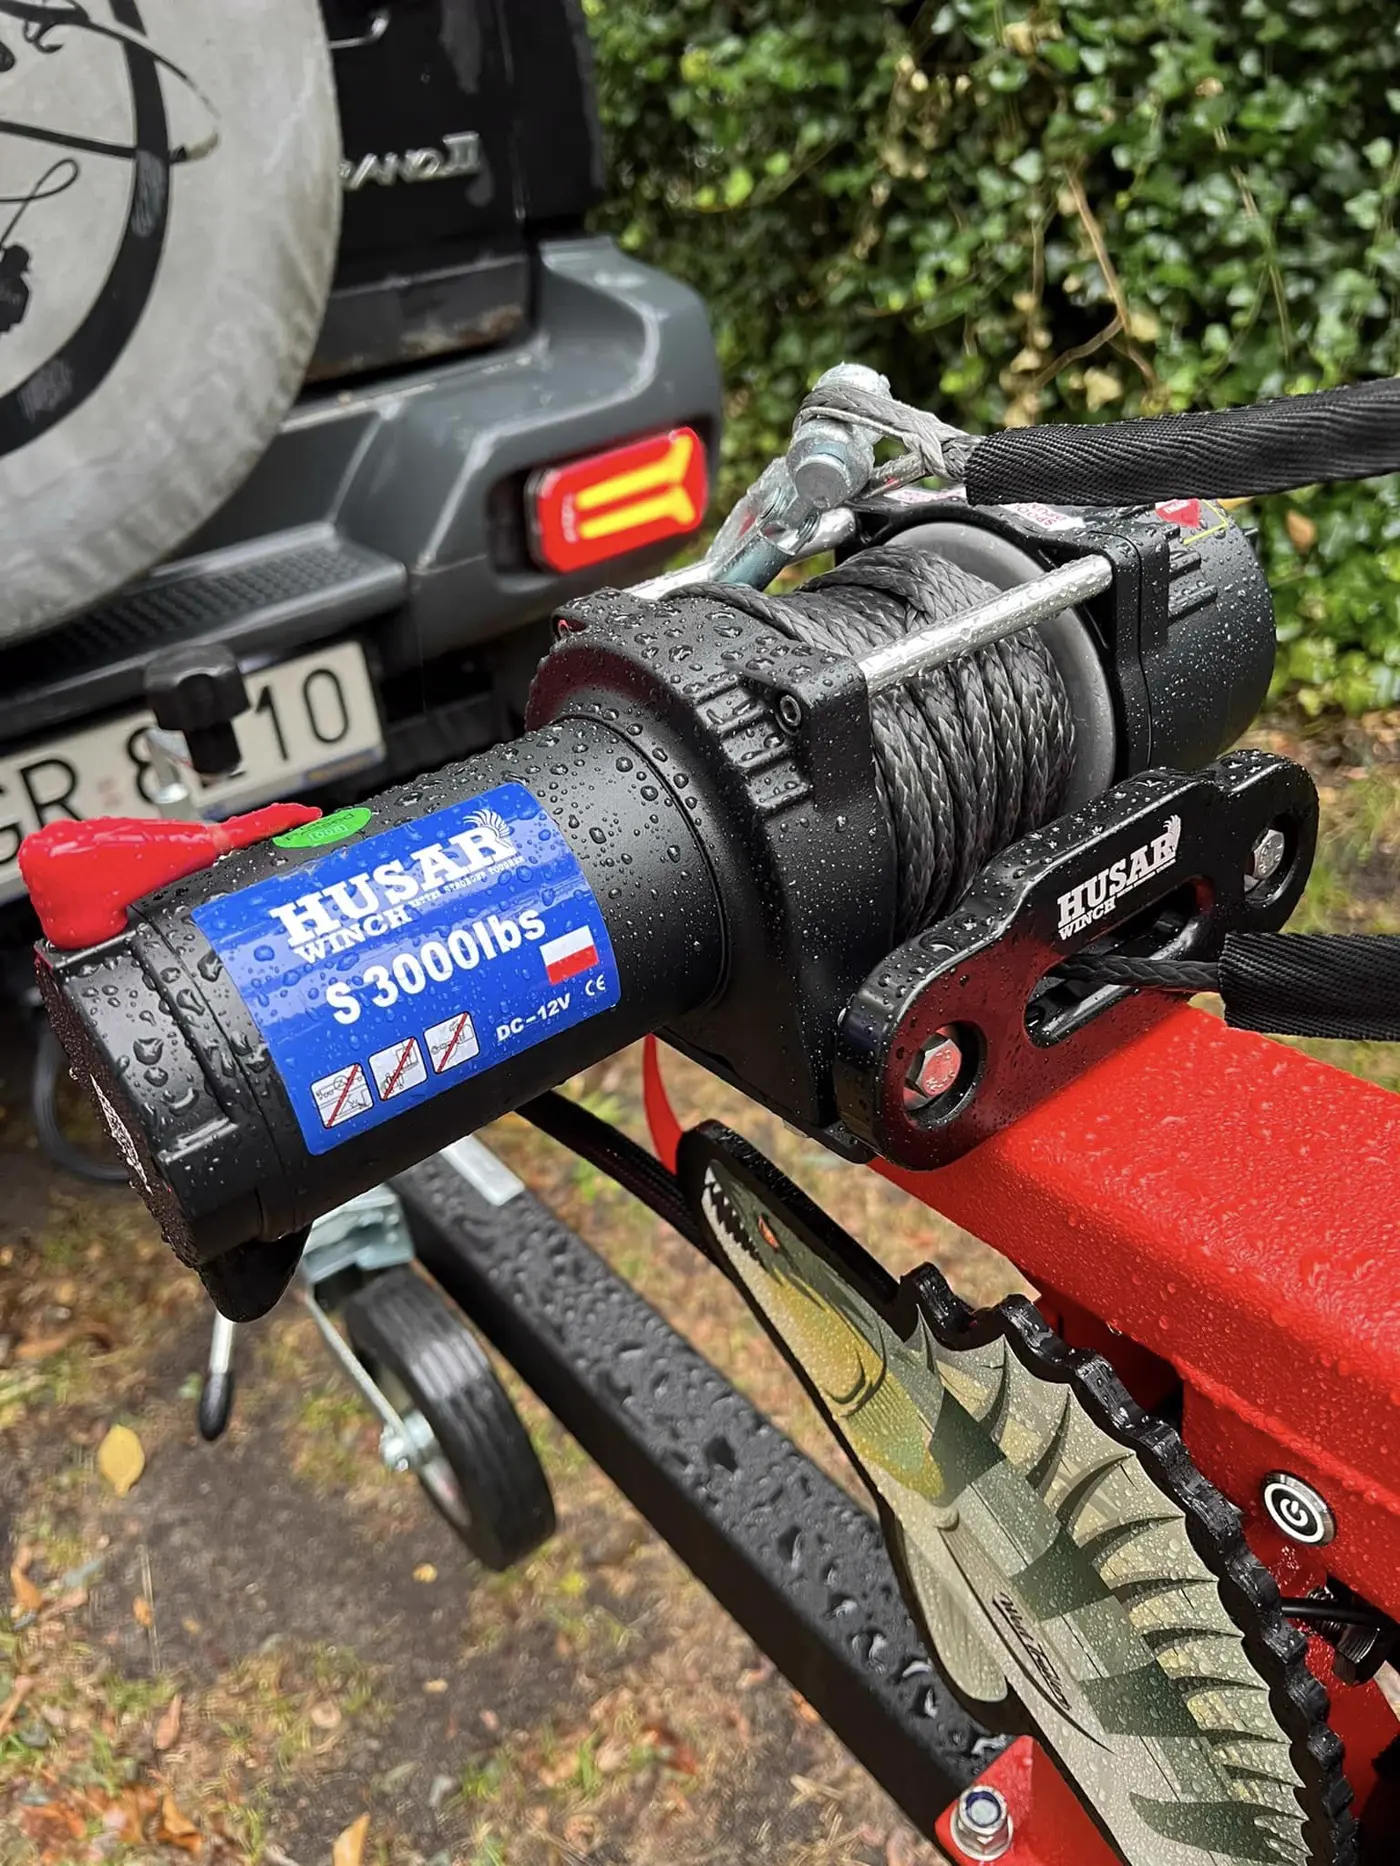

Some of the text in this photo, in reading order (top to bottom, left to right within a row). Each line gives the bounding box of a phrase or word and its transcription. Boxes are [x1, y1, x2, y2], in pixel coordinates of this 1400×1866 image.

[269, 824, 518, 947] HUSAR
[1057, 829, 1181, 929] HUSAR
[294, 908, 412, 965] WINCH
[1058, 896, 1117, 941] WINCH
[325, 909, 547, 1026] S 3000lbs
[496, 992, 571, 1042] DC-12V
